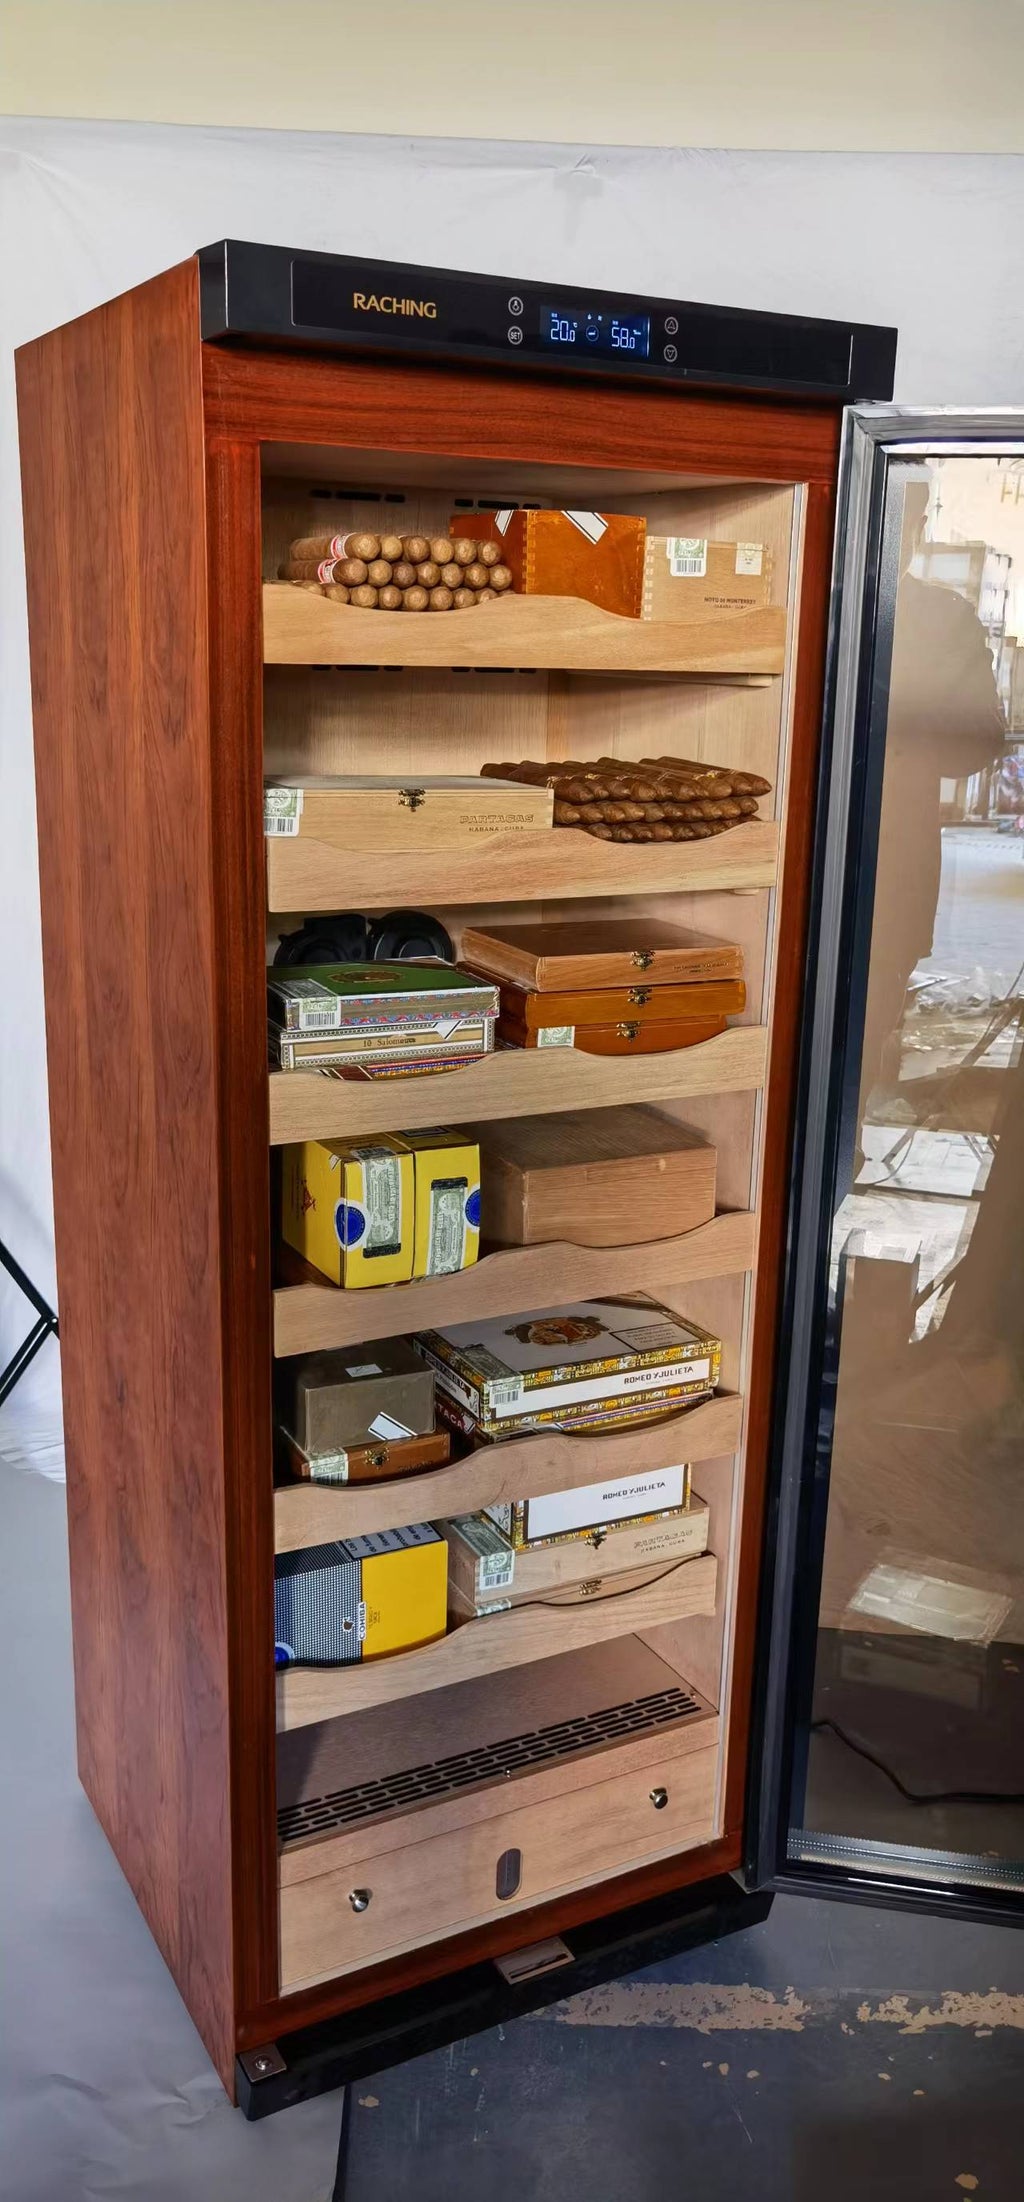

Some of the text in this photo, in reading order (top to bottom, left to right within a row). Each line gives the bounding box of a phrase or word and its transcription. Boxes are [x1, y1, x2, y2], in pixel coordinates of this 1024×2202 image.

[353, 292, 437, 318] RACHING
[510, 331, 521, 341] SET
[460, 814, 534, 823] PARTAGAS
[623, 1373, 652, 1385] ROMEO
[602, 1489, 628, 1500] ROMEO
[358, 1602, 366, 1640] COHIBA
